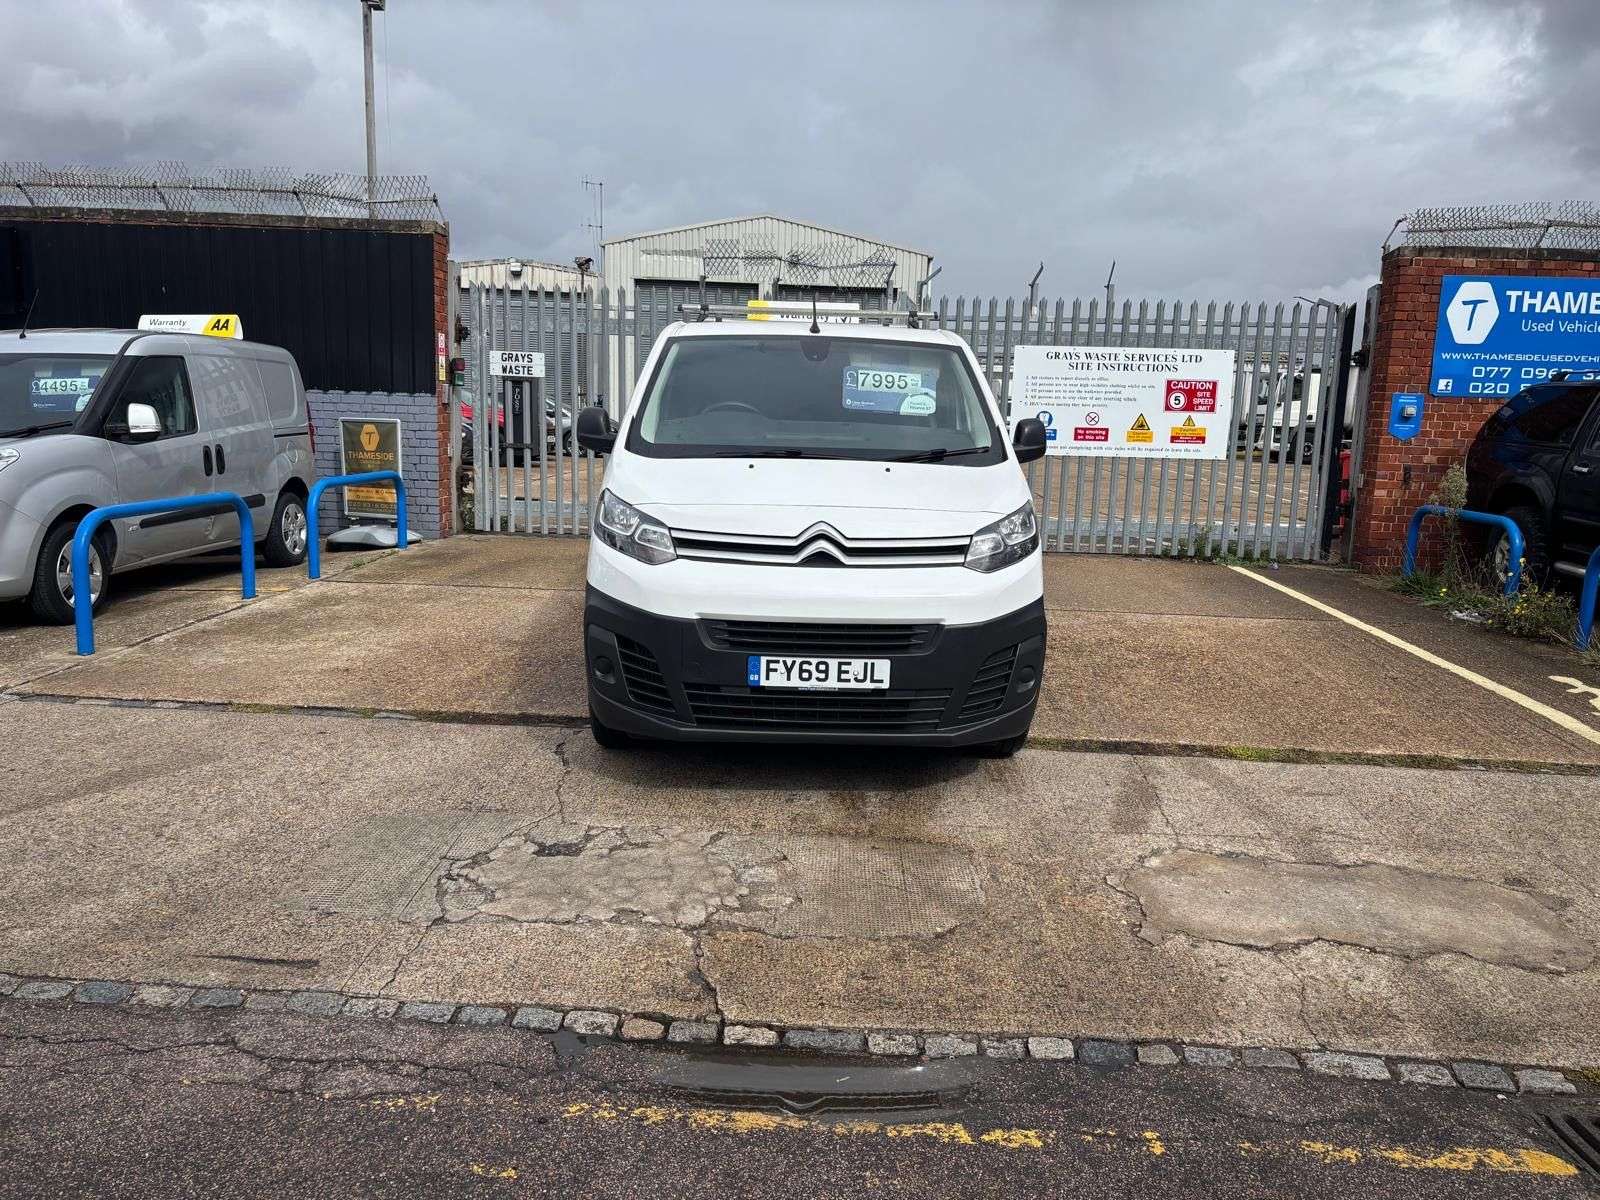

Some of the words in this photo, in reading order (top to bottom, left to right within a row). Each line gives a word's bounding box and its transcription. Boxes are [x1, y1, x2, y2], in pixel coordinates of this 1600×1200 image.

[1462, 299, 1489, 331] T
[149, 318, 187, 326] Warranty
[211, 318, 230, 331] AA
[1522, 320, 1554, 332] Used
[501, 352, 533, 363] GRAYS
[1046, 352, 1080, 361] GRAYS
[1085, 352, 1120, 362] WASTE
[1124, 354, 1178, 363] SERVICES
[1182, 354, 1202, 363] LTD
[502, 366, 533, 375] WASTE
[1068, 362, 1092, 371] SITE
[1097, 362, 1178, 372] INSTRUCTIONS
[1472, 366, 1511, 378] 077
[32, 380, 78, 392] £4495
[846, 371, 908, 390] £7995
[1170, 381, 1212, 390] CAUTION
[1469, 382, 1509, 394] 020
[1174, 395, 1181, 405] 5
[766, 660, 829, 682] FY69
[837, 662, 884, 684] EJL
